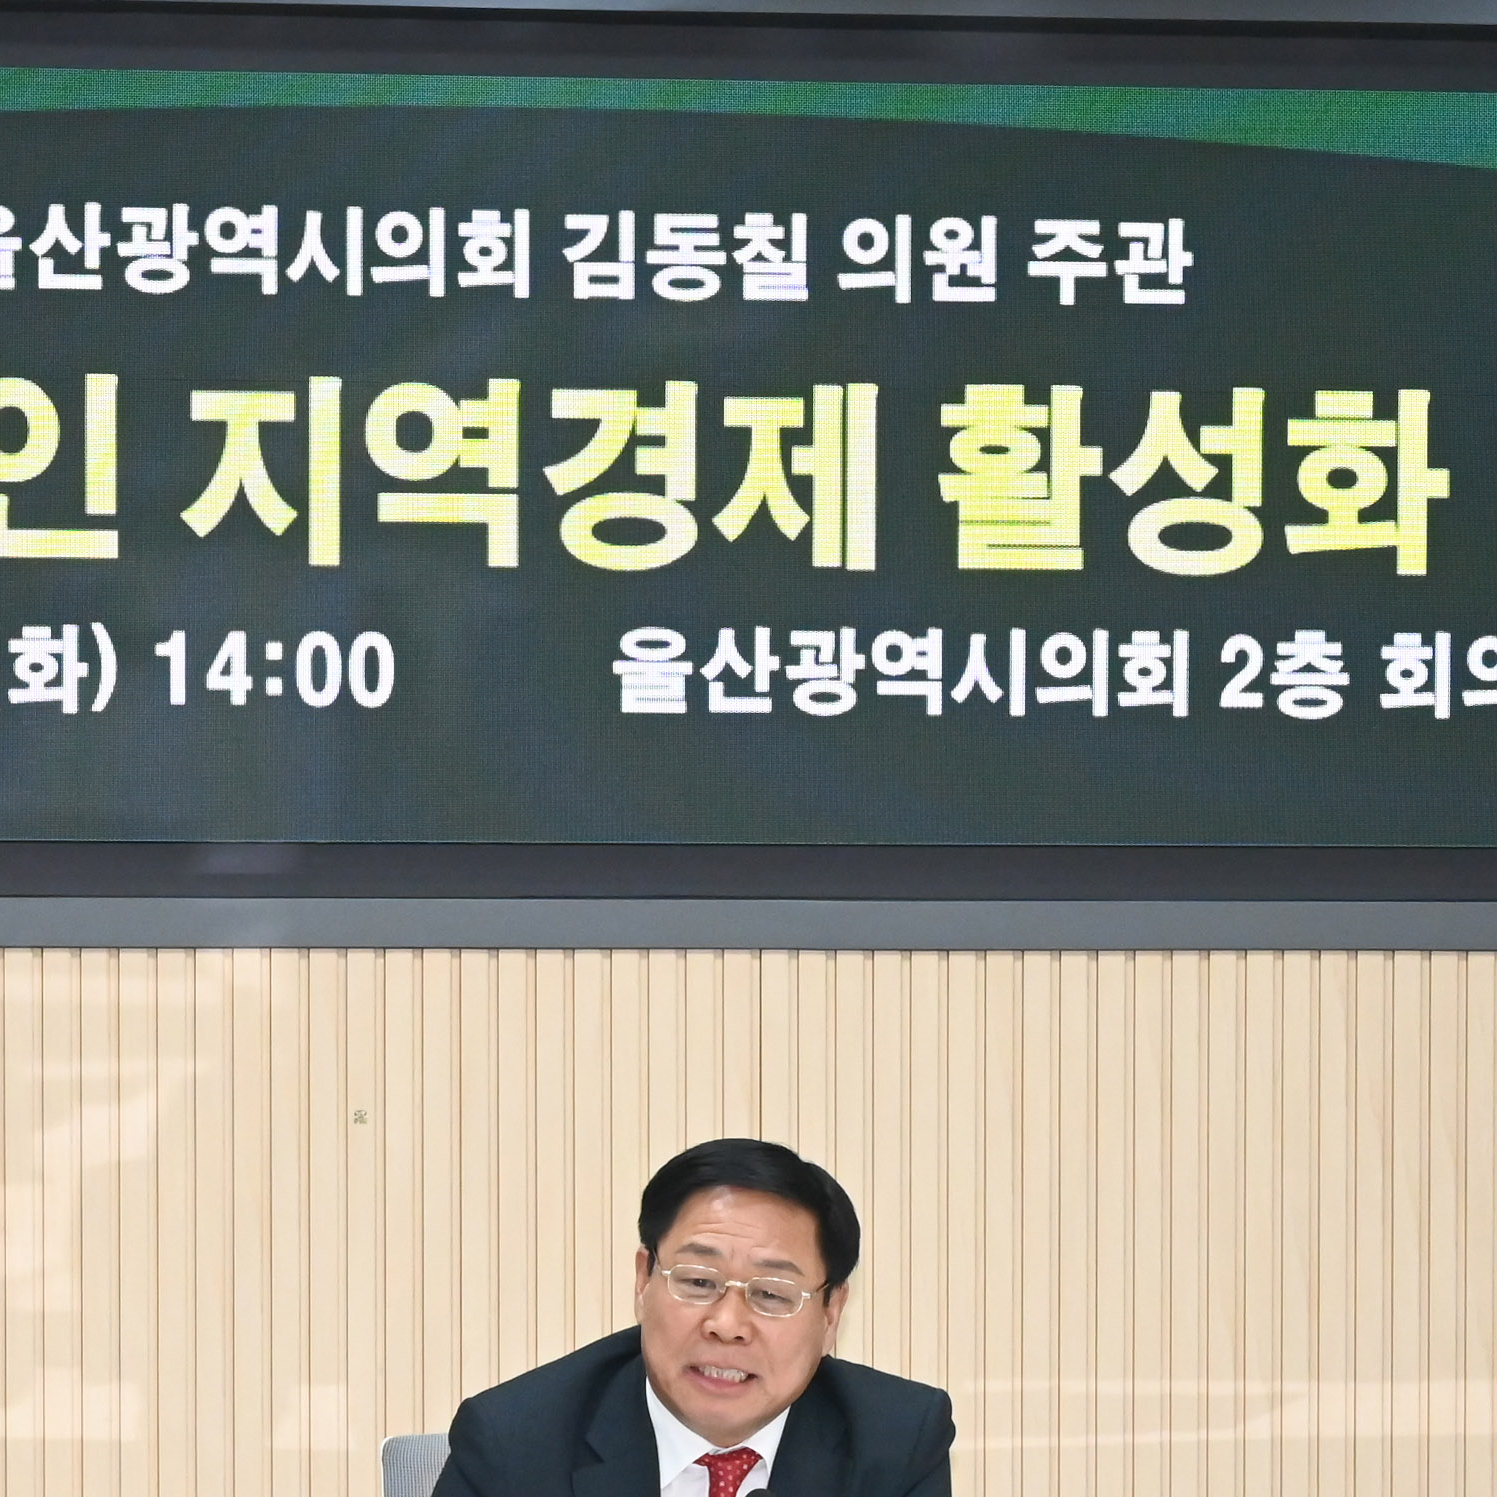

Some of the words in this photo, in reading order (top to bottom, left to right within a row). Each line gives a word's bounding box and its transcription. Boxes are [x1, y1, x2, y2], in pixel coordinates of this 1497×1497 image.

[562, 209, 809, 303] 김동칠
[837, 213, 998, 304] 의원
[1027, 217, 1194, 306] 주관
[179, 375, 879, 572] 지역경제
[937, 383, 1451, 577] 활성화
[154, 629, 395, 709] 14:00
[612, 625, 1190, 718] 울산광역시의회
[1219, 629, 1350, 720] 2층
